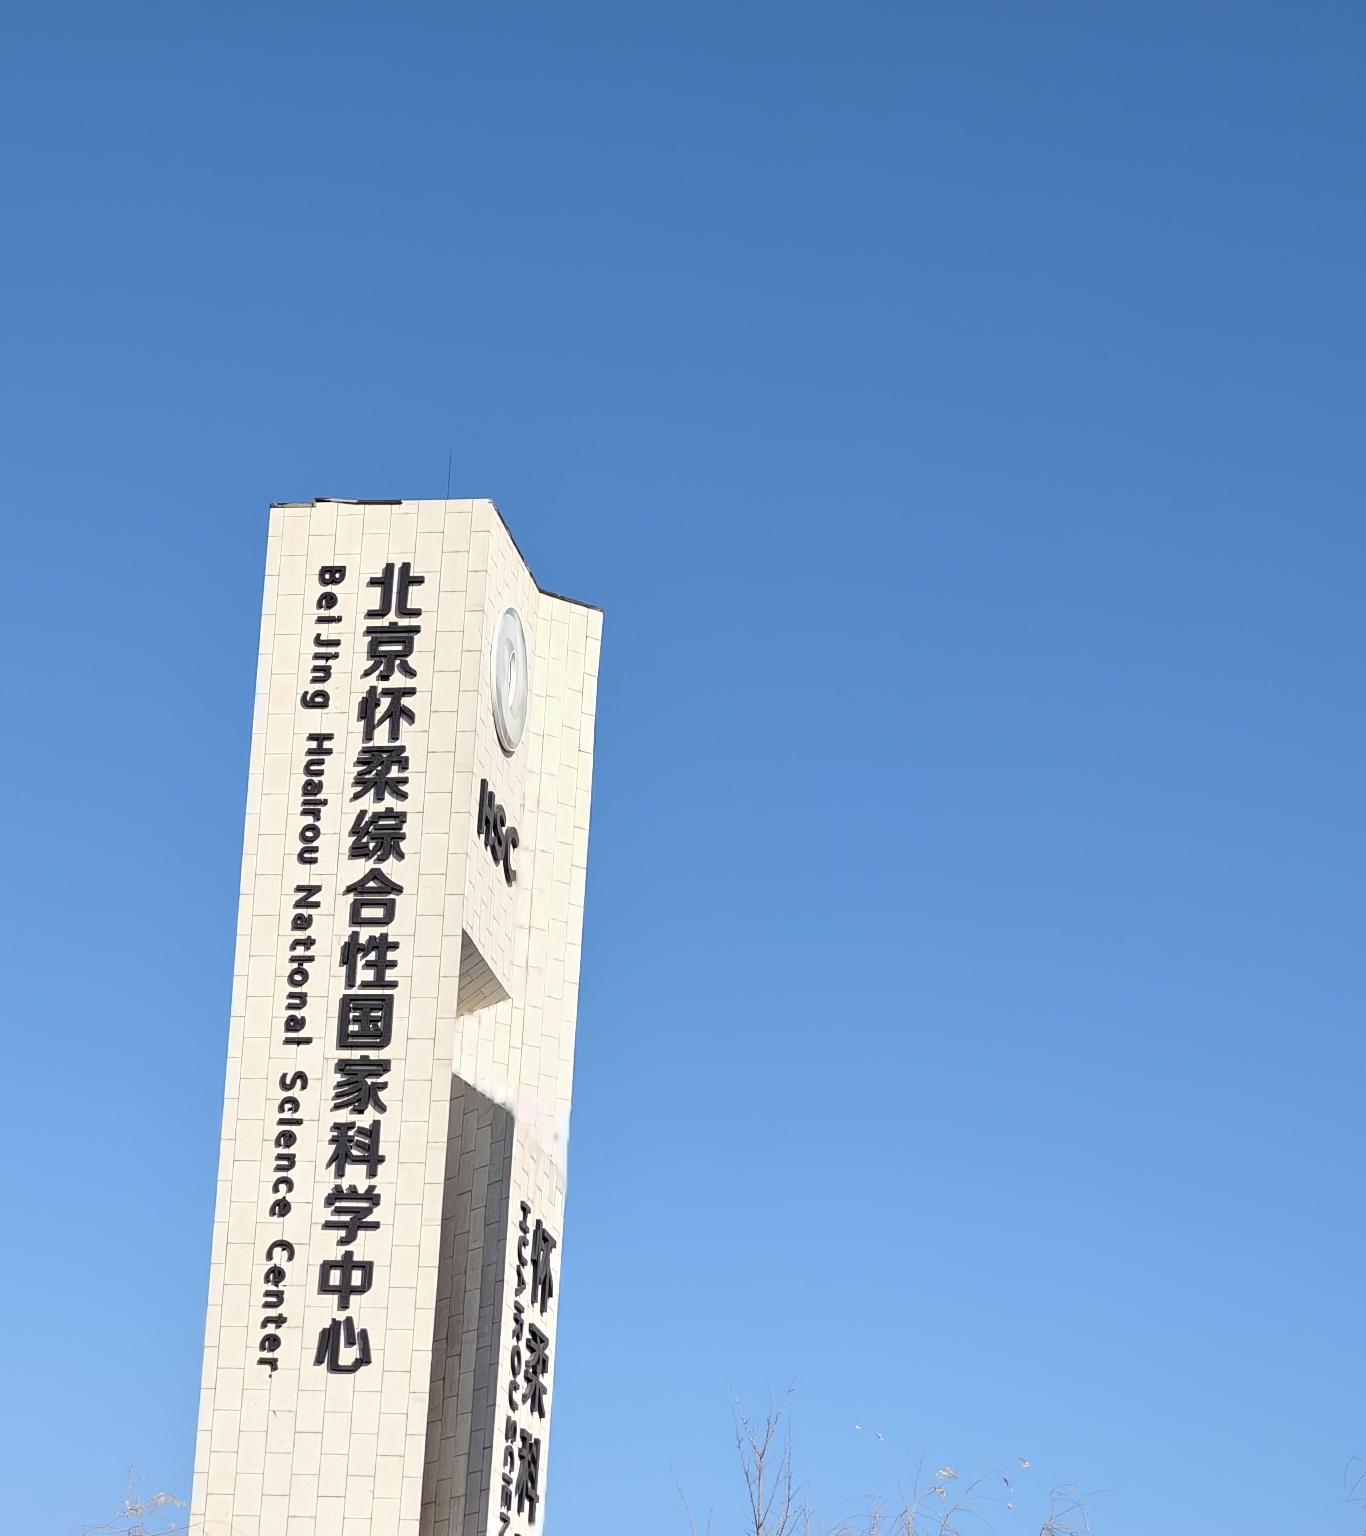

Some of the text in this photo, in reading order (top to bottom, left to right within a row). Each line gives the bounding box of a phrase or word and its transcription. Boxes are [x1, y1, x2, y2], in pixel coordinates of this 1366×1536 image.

[298, 733, 335, 865] Huairou
[477, 779, 519, 886] HSC
[283, 885, 322, 1046] National
[314, 562, 425, 1374] 北京怀柔综合性国家科学中心
[270, 1071, 308, 1217] Science
[258, 1240, 295, 1373] Center
